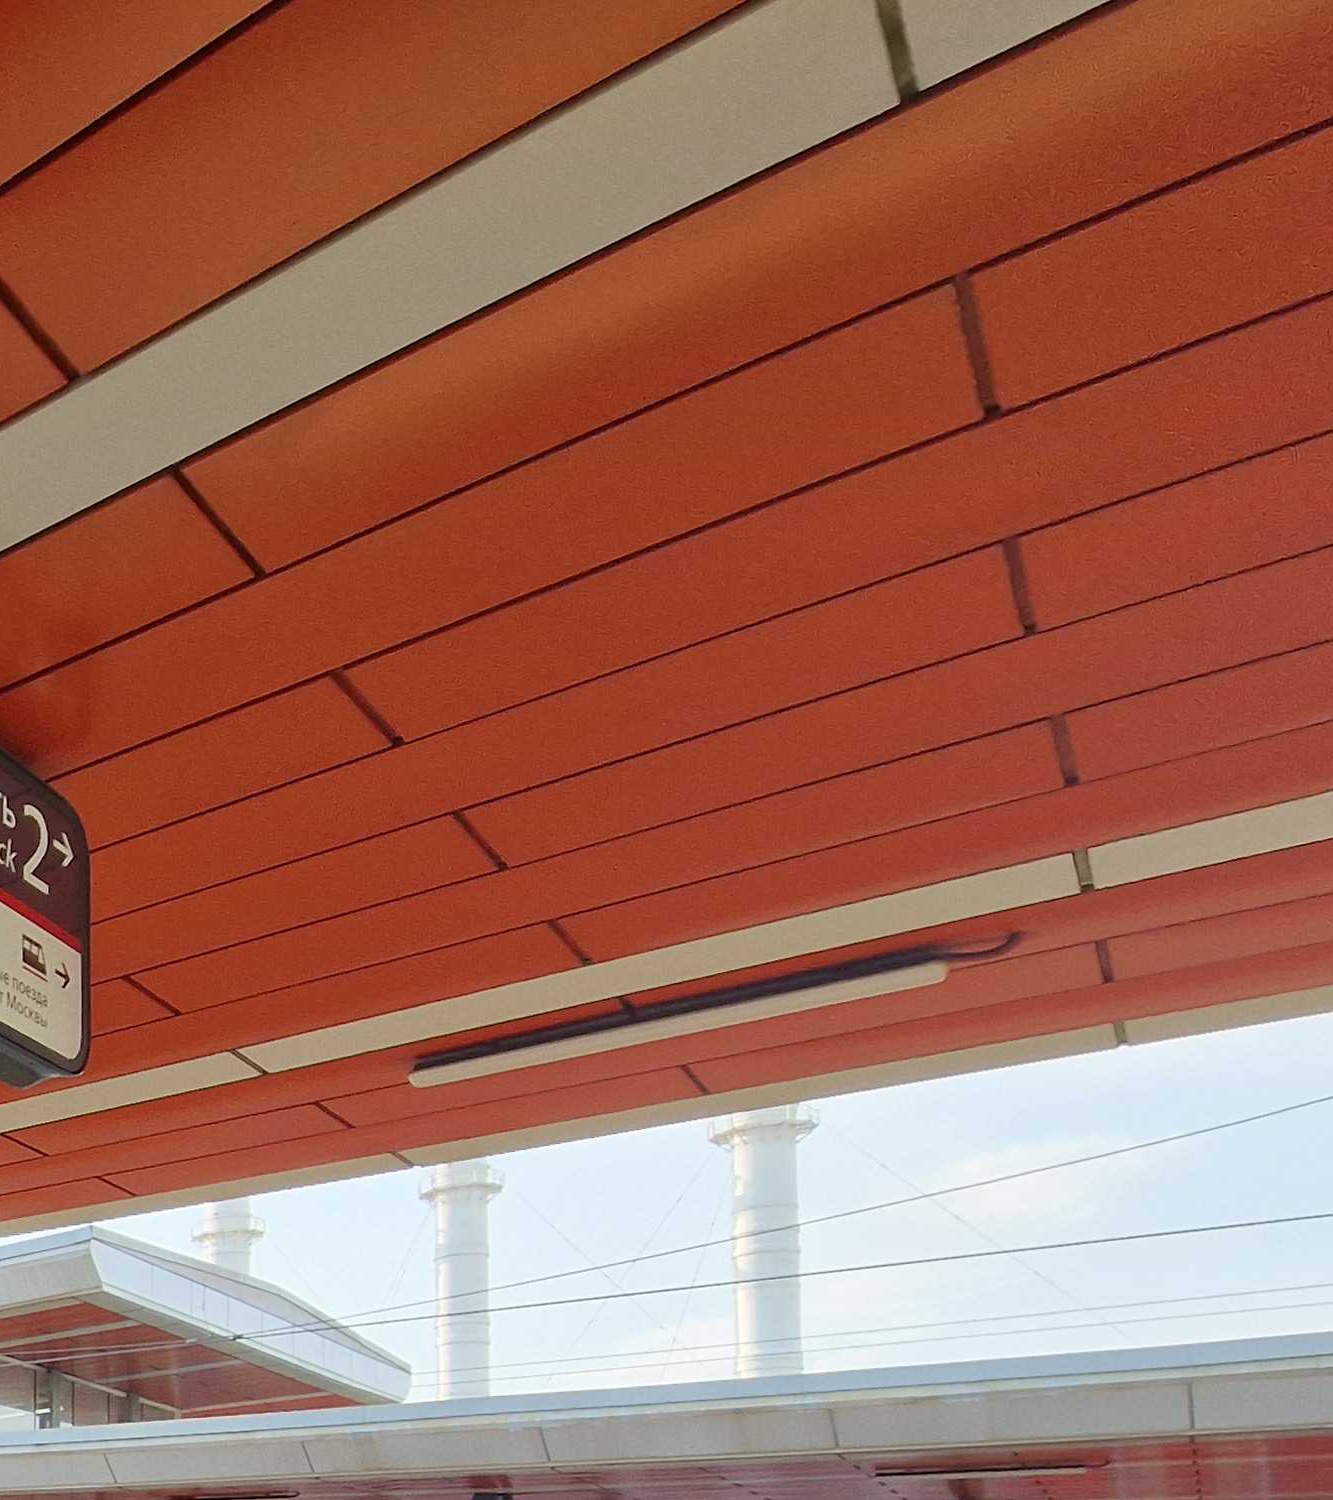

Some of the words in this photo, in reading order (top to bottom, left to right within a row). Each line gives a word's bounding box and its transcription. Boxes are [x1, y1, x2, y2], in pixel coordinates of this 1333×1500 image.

[23, 804, 50, 895] 2
[6, 992, 48, 1028] Москвы
[12, 977, 49, 1008] поезда
